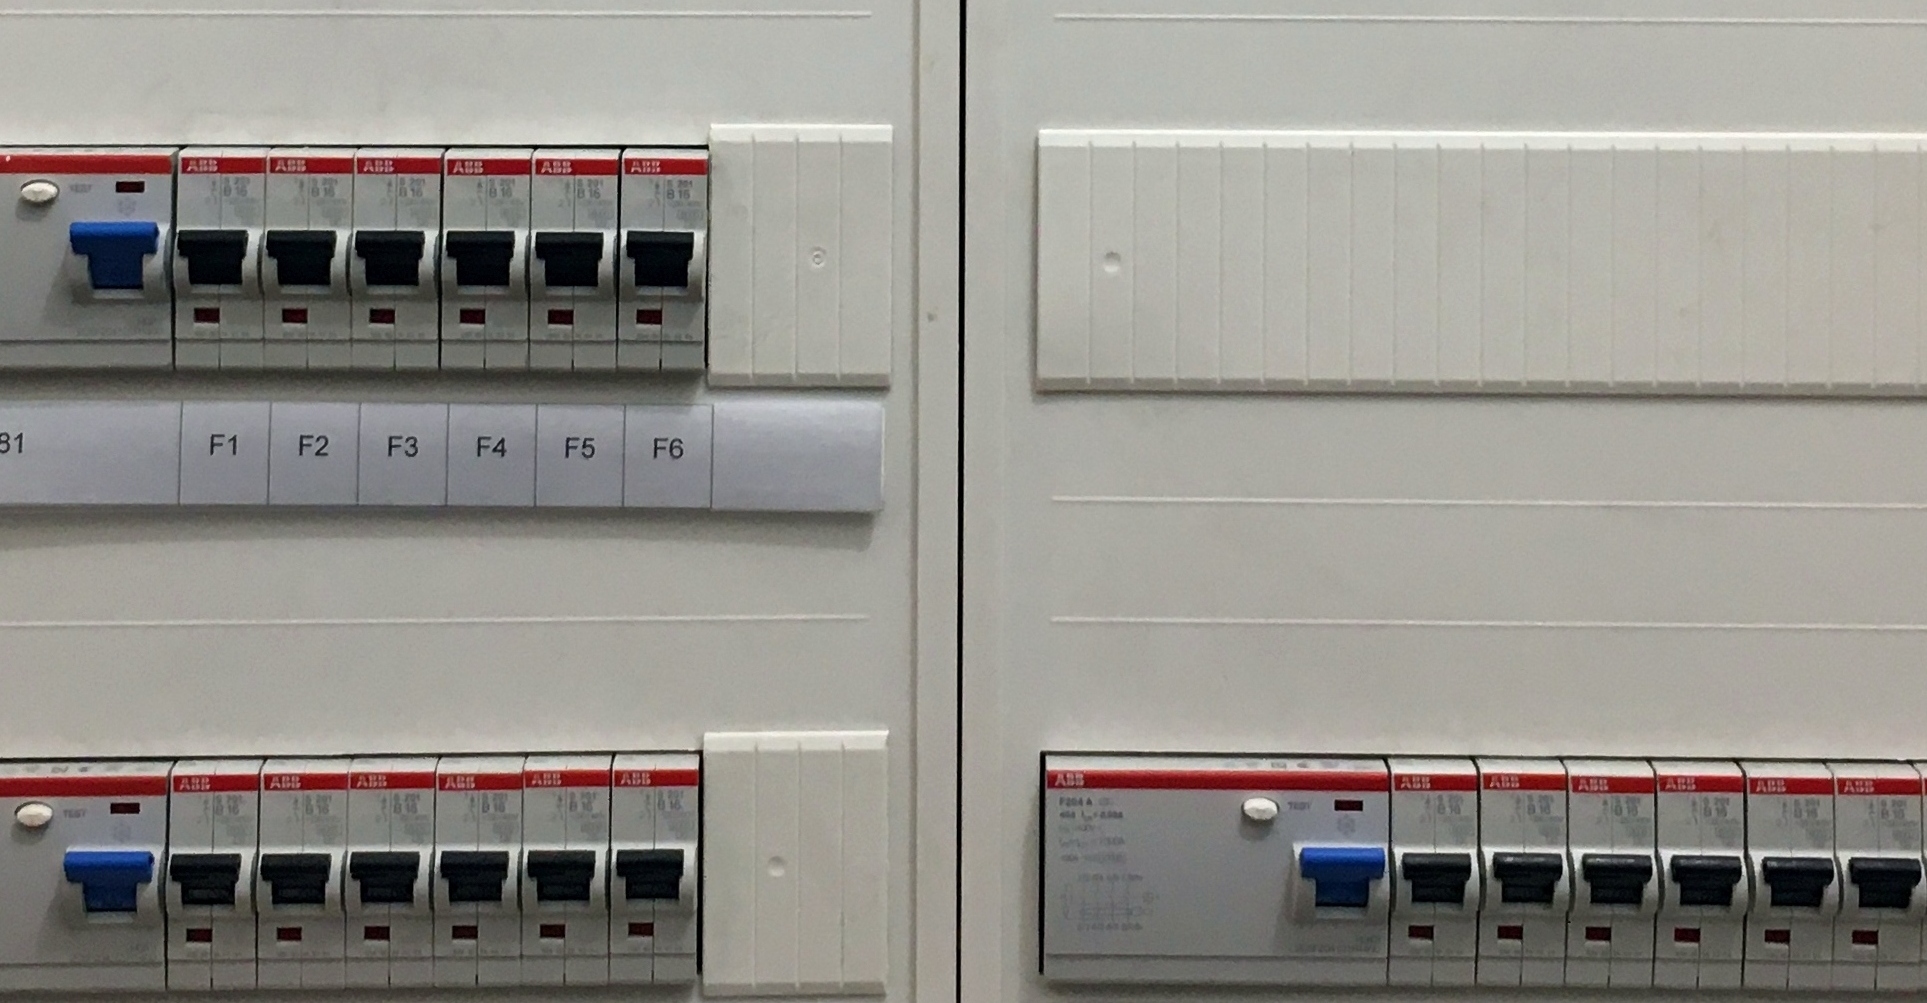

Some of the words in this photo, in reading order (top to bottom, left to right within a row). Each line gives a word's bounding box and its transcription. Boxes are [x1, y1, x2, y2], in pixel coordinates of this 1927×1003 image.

[187, 160, 218, 171] ABB
[275, 160, 306, 171] ABB
[363, 161, 394, 172] ABB
[453, 161, 484, 173] ABB
[541, 161, 572, 173] ABB
[631, 161, 661, 173] ABB
[236, 186, 248, 196] 16
[323, 187, 335, 197] 16
[411, 187, 423, 197] 16
[501, 188, 512, 198] 16
[589, 188, 600, 198] 16
[679, 189, 690, 199] 16
[210, 434, 238, 455] F1
[299, 435, 329, 456] F2
[387, 436, 419, 457] F3
[476, 437, 507, 457] F4
[564, 437, 596, 458] F5
[653, 438, 684, 458] F6
[179, 778, 210, 790] ABB
[270, 776, 301, 788] ABB
[357, 775, 387, 787] ABB
[445, 777, 475, 789] ABB
[531, 773, 561, 785] ABB
[621, 773, 651, 785] ABB
[1055, 773, 1084, 786] ABB
[1400, 777, 1430, 789] ABB
[1490, 776, 1520, 788] ABB
[1578, 779, 1608, 791] ABB
[1665, 778, 1696, 790] ABB
[1756, 781, 1786, 792] ABB
[1844, 781, 1874, 793] ABB
